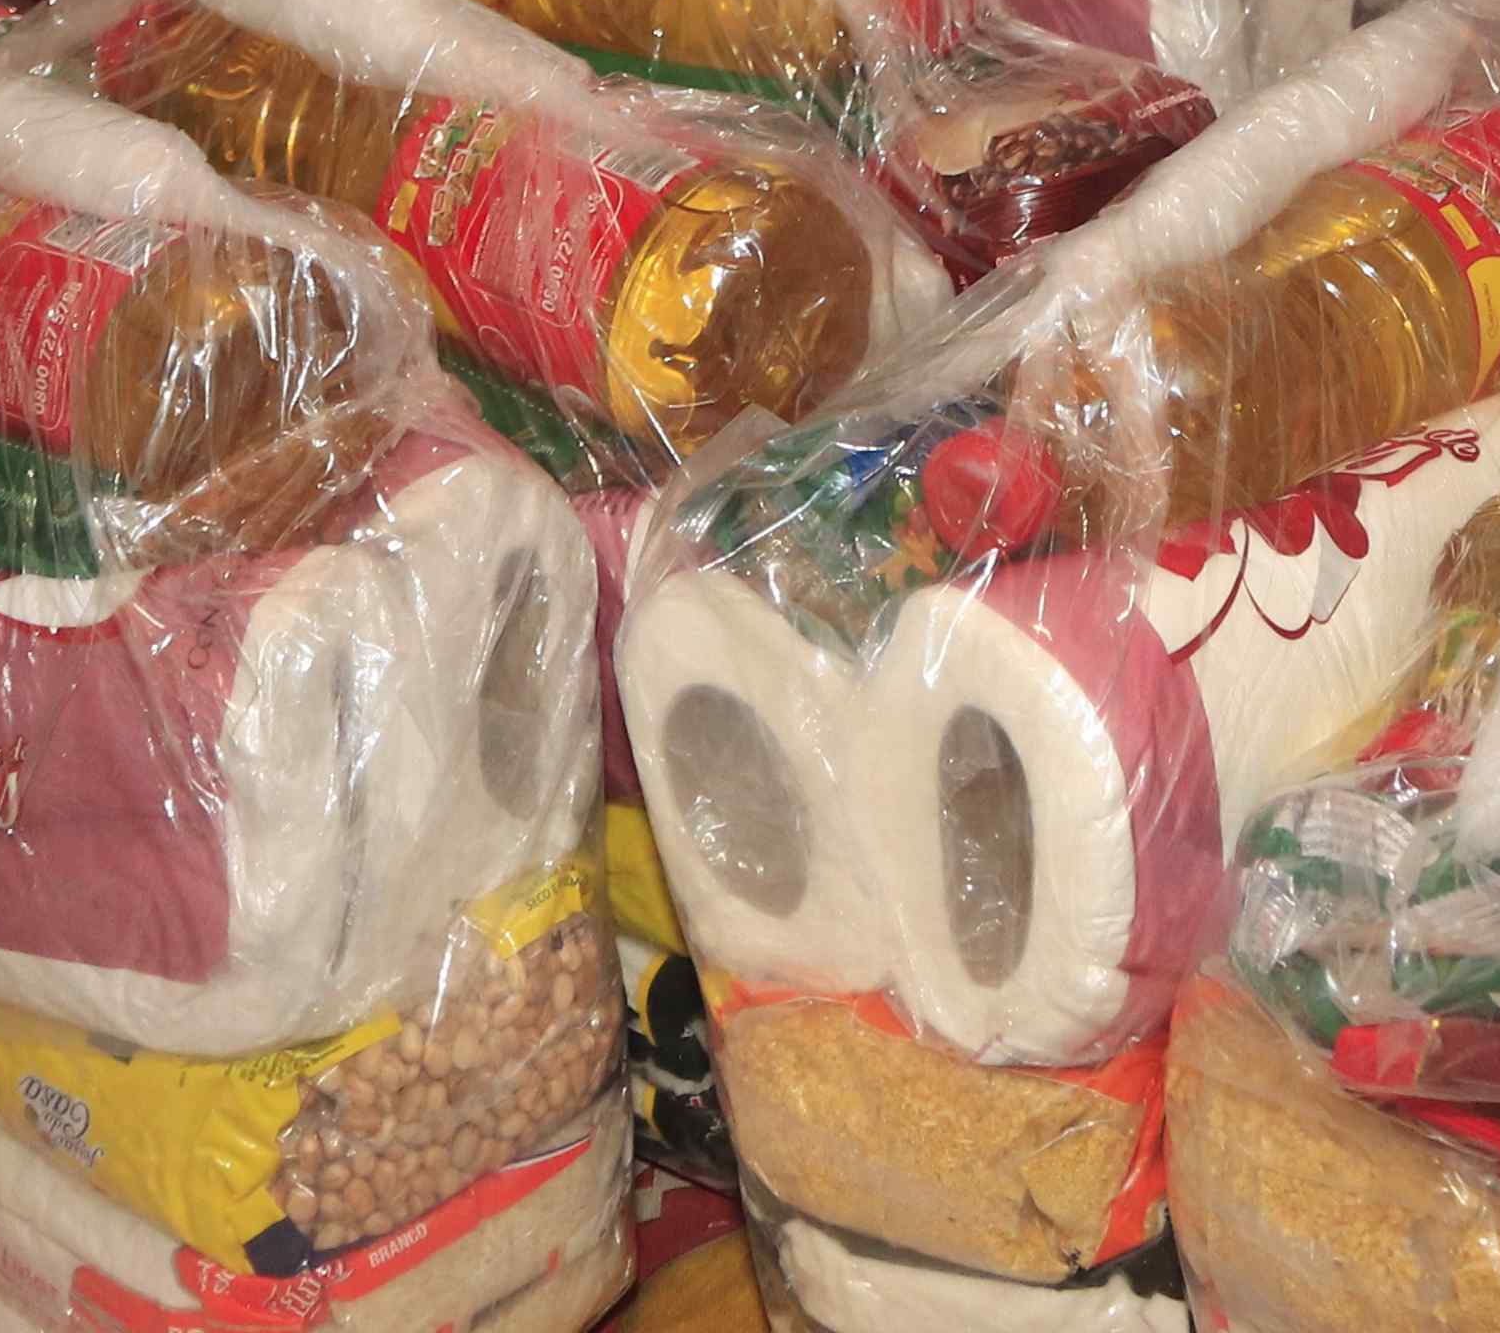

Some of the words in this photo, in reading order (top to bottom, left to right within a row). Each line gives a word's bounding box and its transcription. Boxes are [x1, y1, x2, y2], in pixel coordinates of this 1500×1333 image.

[37, 326, 58, 360] 727
[31, 365, 50, 414] 0800
[15, 1071, 94, 1145] Casa
[368, 1222, 430, 1269] BRANCO
